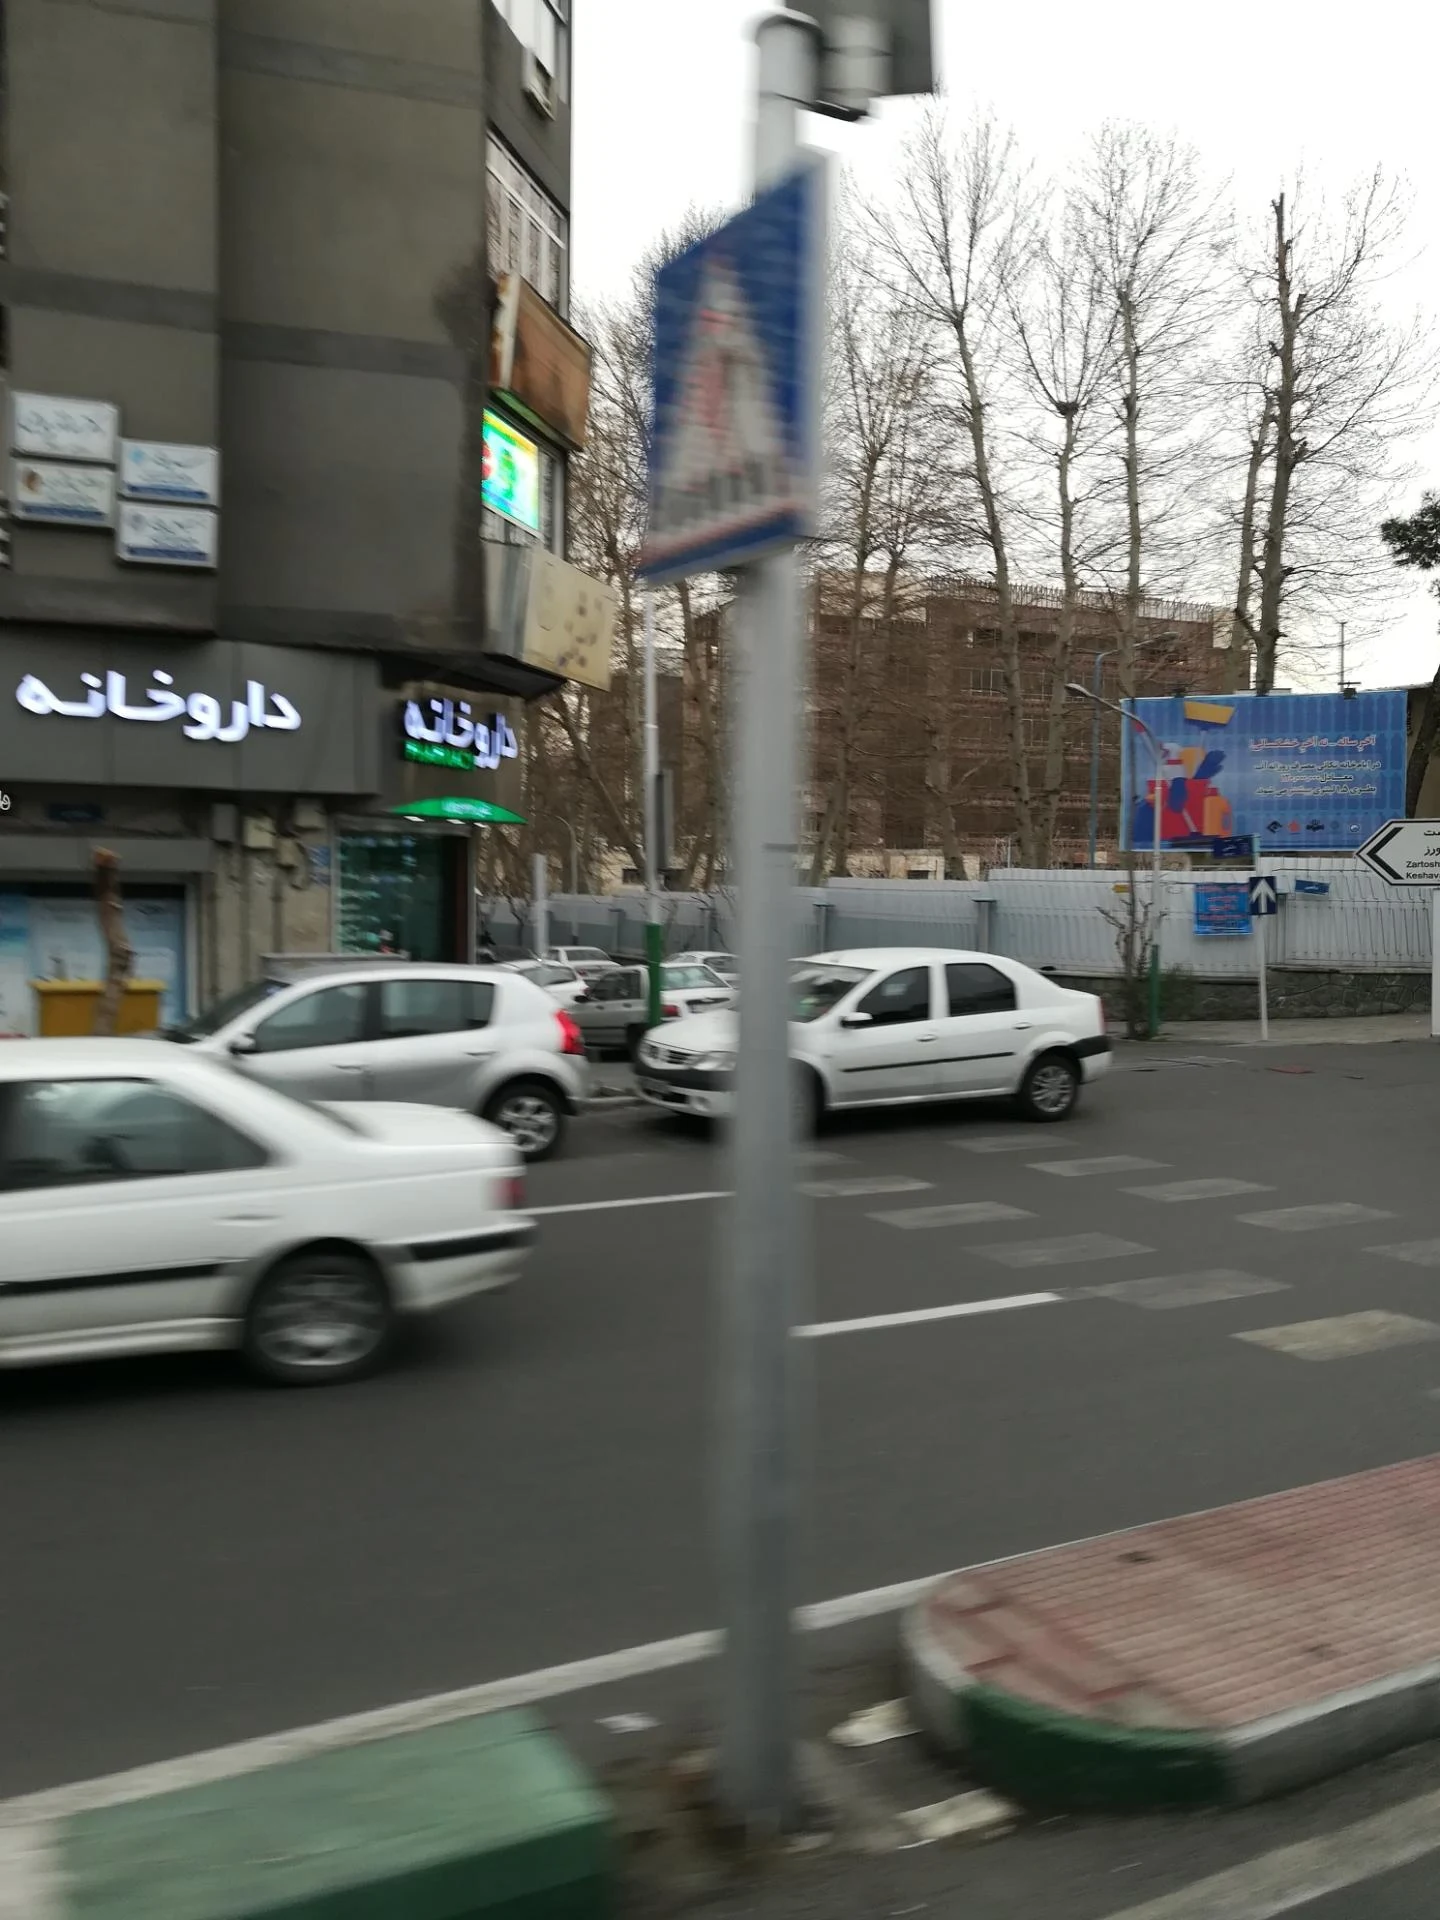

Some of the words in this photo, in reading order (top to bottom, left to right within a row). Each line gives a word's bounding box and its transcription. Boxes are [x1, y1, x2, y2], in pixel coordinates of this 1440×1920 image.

[15, 669, 302, 742] داروخانه
[404, 698, 519, 770] داروخانه
[1406, 872, 1440, 880] Keshav
